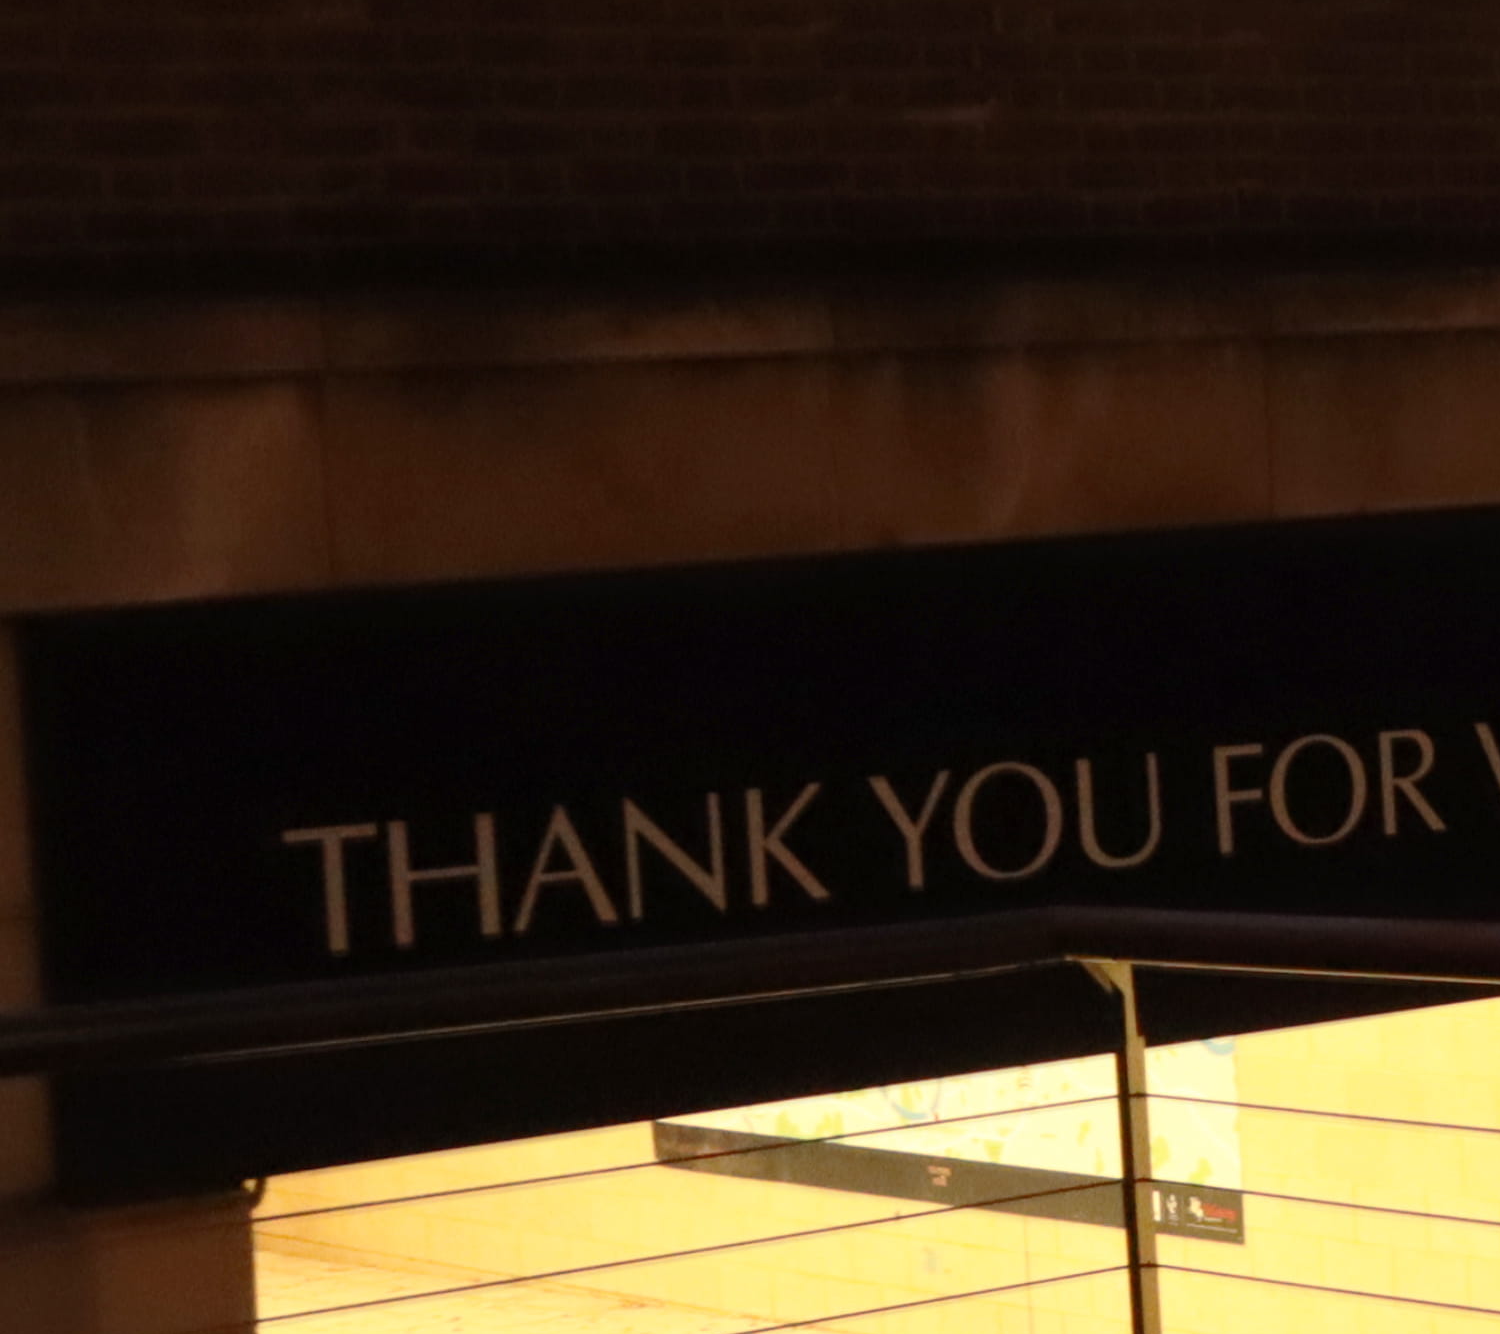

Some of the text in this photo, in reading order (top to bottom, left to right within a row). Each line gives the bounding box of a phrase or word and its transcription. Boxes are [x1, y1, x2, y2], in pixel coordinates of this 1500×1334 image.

[281, 781, 833, 958] THANK
[868, 751, 1165, 892] YOU
[1212, 727, 1448, 857] FOR
